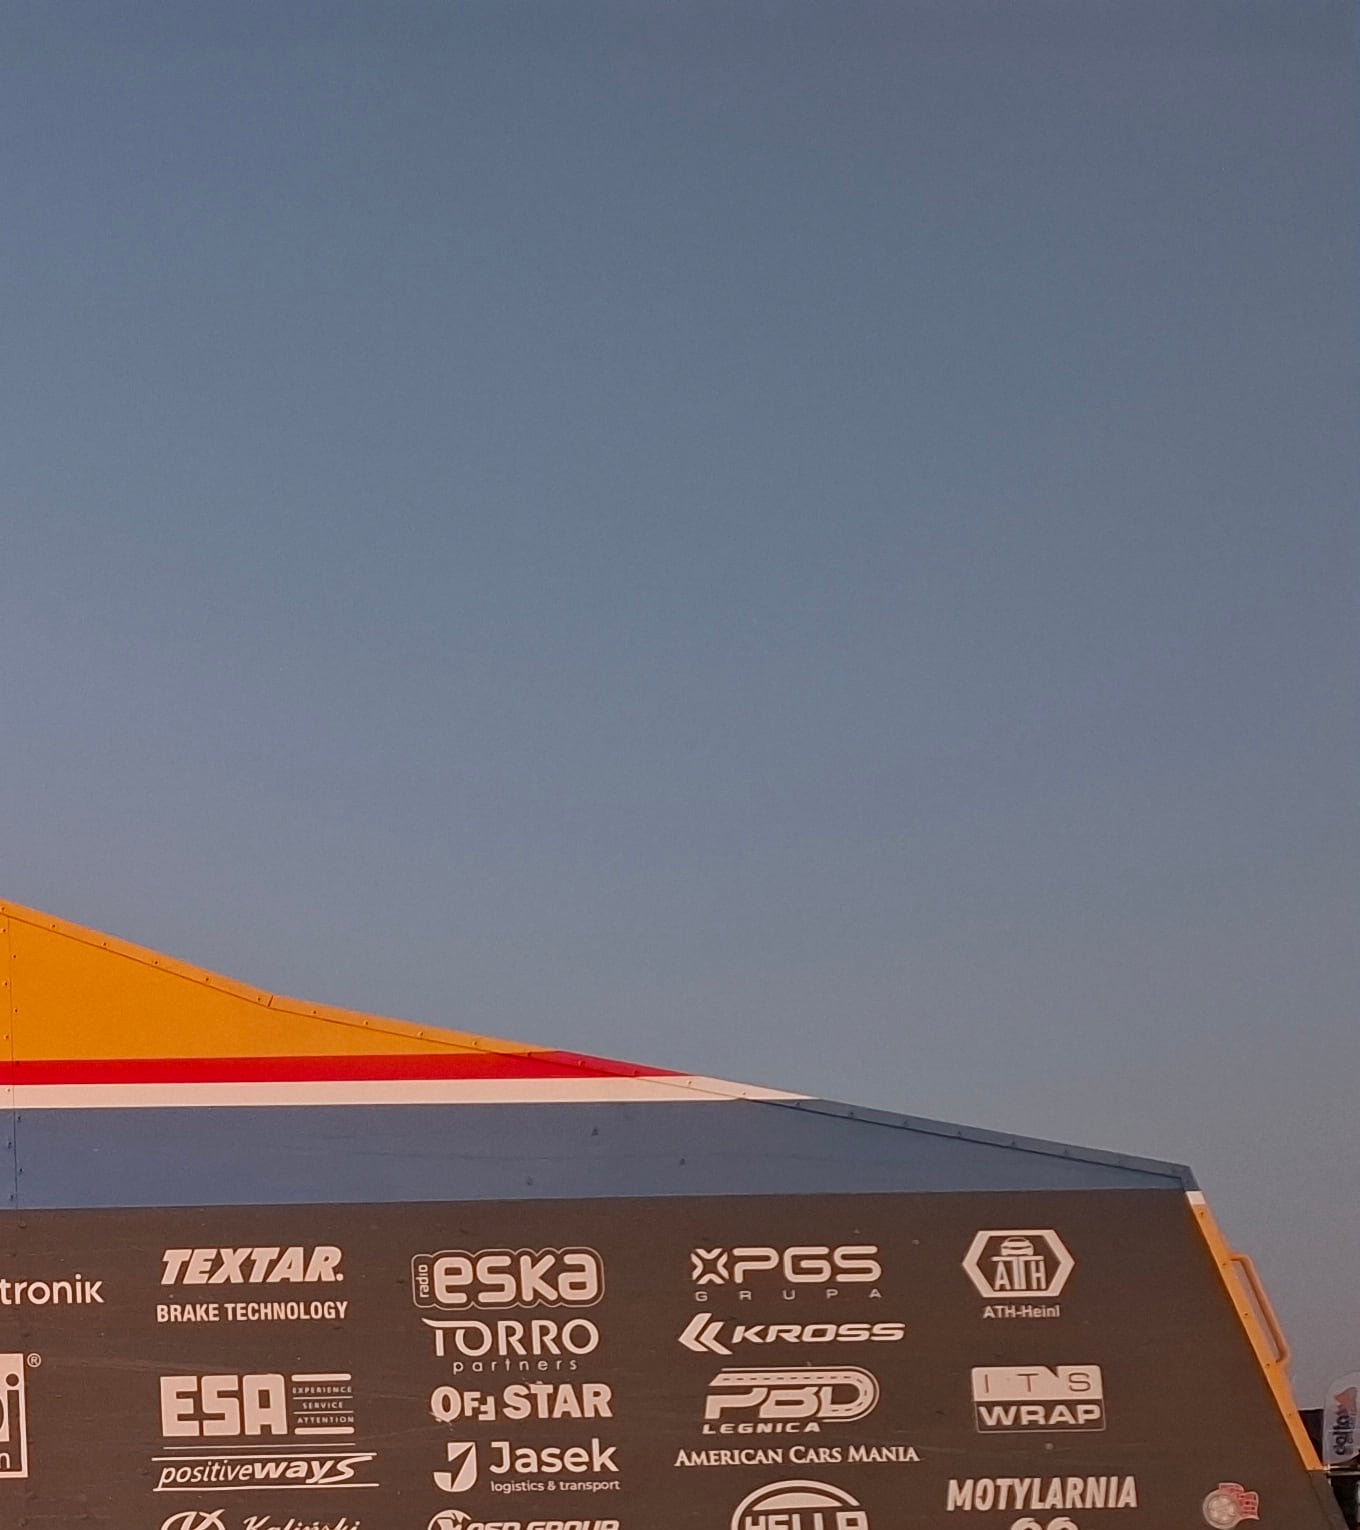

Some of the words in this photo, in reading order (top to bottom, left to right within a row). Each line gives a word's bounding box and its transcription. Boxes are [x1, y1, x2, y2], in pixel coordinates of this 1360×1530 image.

[417, 1263, 430, 1298] radio
[434, 1253, 598, 1303] eska
[695, 1289, 882, 1301] GRUPA
[157, 1303, 220, 1322] BRAKE
[224, 1302, 348, 1320] TECHNOLOGY
[422, 1318, 599, 1356] TORRO
[732, 1323, 906, 1343] KROSS
[453, 1359, 577, 1374] partners
[984, 1372, 1092, 1393] ITS
[160, 1374, 288, 1436] ESA
[502, 1383, 613, 1419] STAR
[979, 1404, 1102, 1427] WRAP
[702, 1422, 821, 1434] LEGNICA
[489, 1438, 619, 1473] Jasek
[789, 1446, 842, 1464] CARS
[848, 1446, 920, 1462] MANIA
[490, 1480, 545, 1493] logistics
[559, 1479, 621, 1493] transport
[947, 1476, 1137, 1511] MOTYLARNIA
